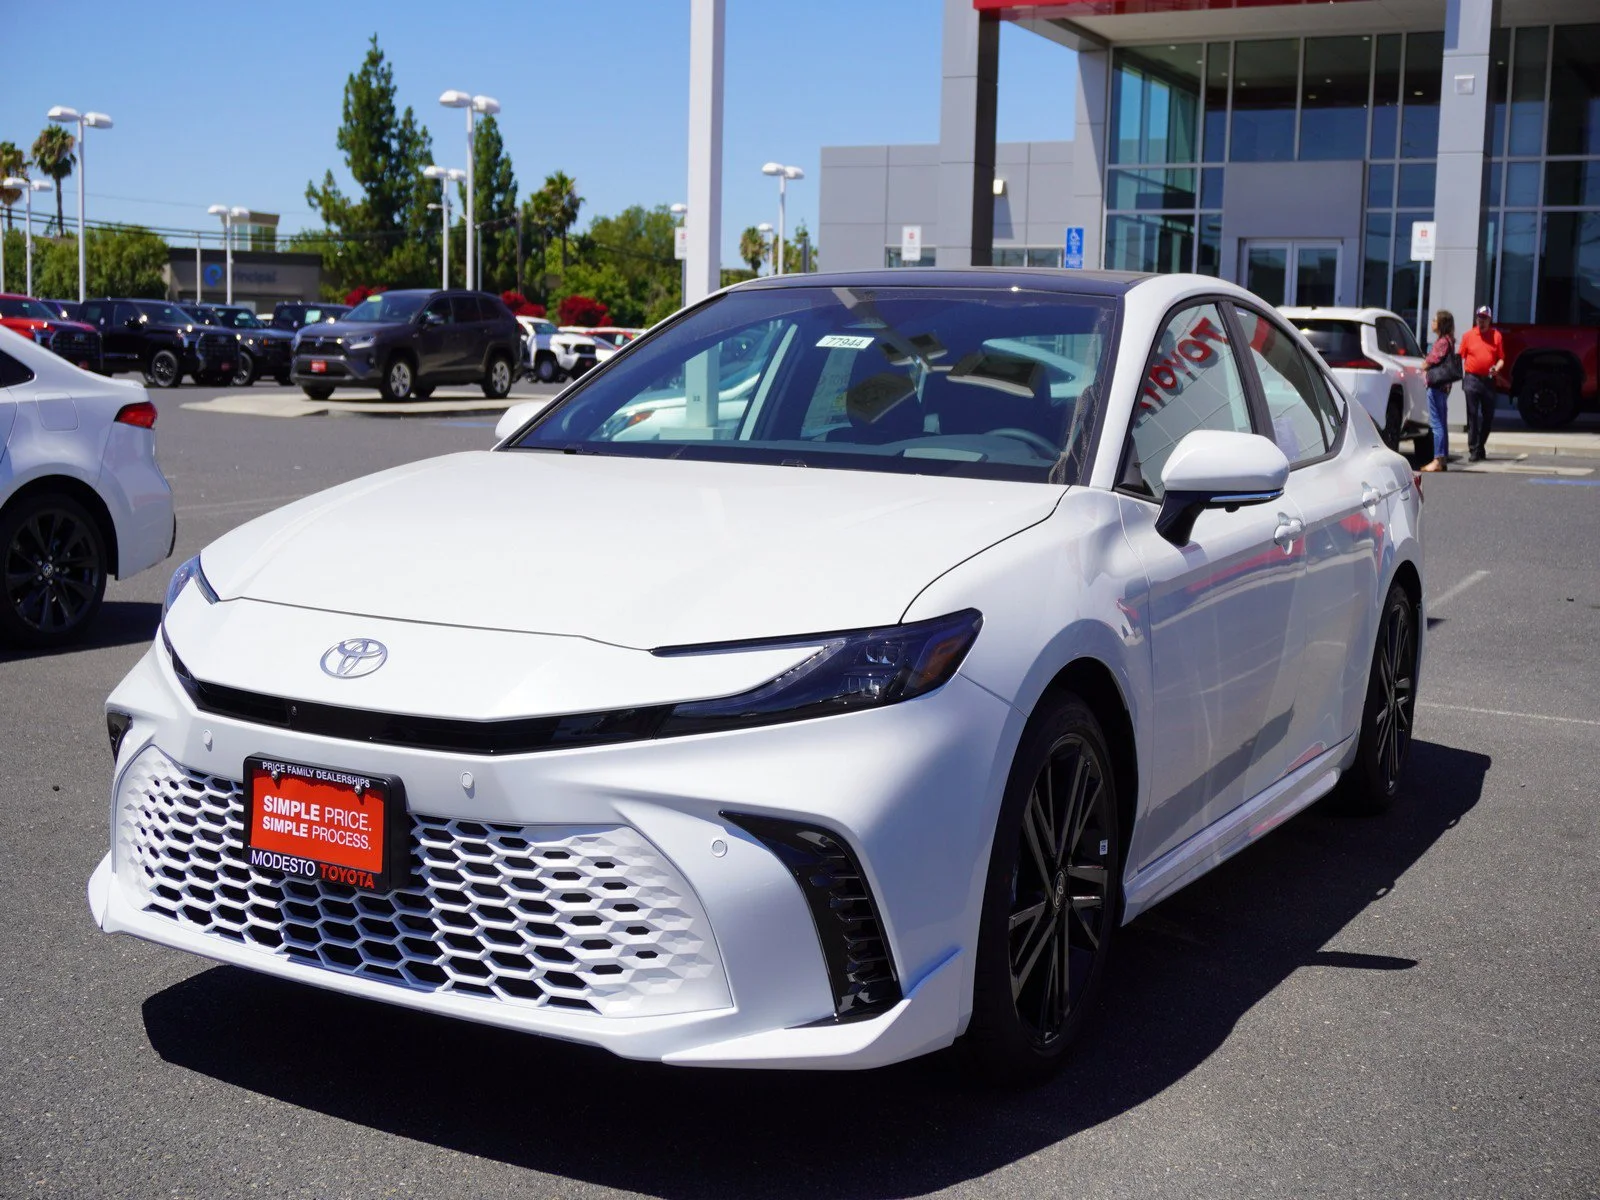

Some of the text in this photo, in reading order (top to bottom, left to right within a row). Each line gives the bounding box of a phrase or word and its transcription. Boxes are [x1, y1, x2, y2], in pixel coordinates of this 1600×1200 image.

[825, 337, 865, 347] 77944
[262, 761, 370, 788] PRICE FAMILY DEALERSHIPS
[263, 795, 372, 832] SIMPLE PRICE.
[262, 815, 371, 850] SIMPLE PROCESS.
[251, 849, 375, 889] MODESTO TOYOTA
